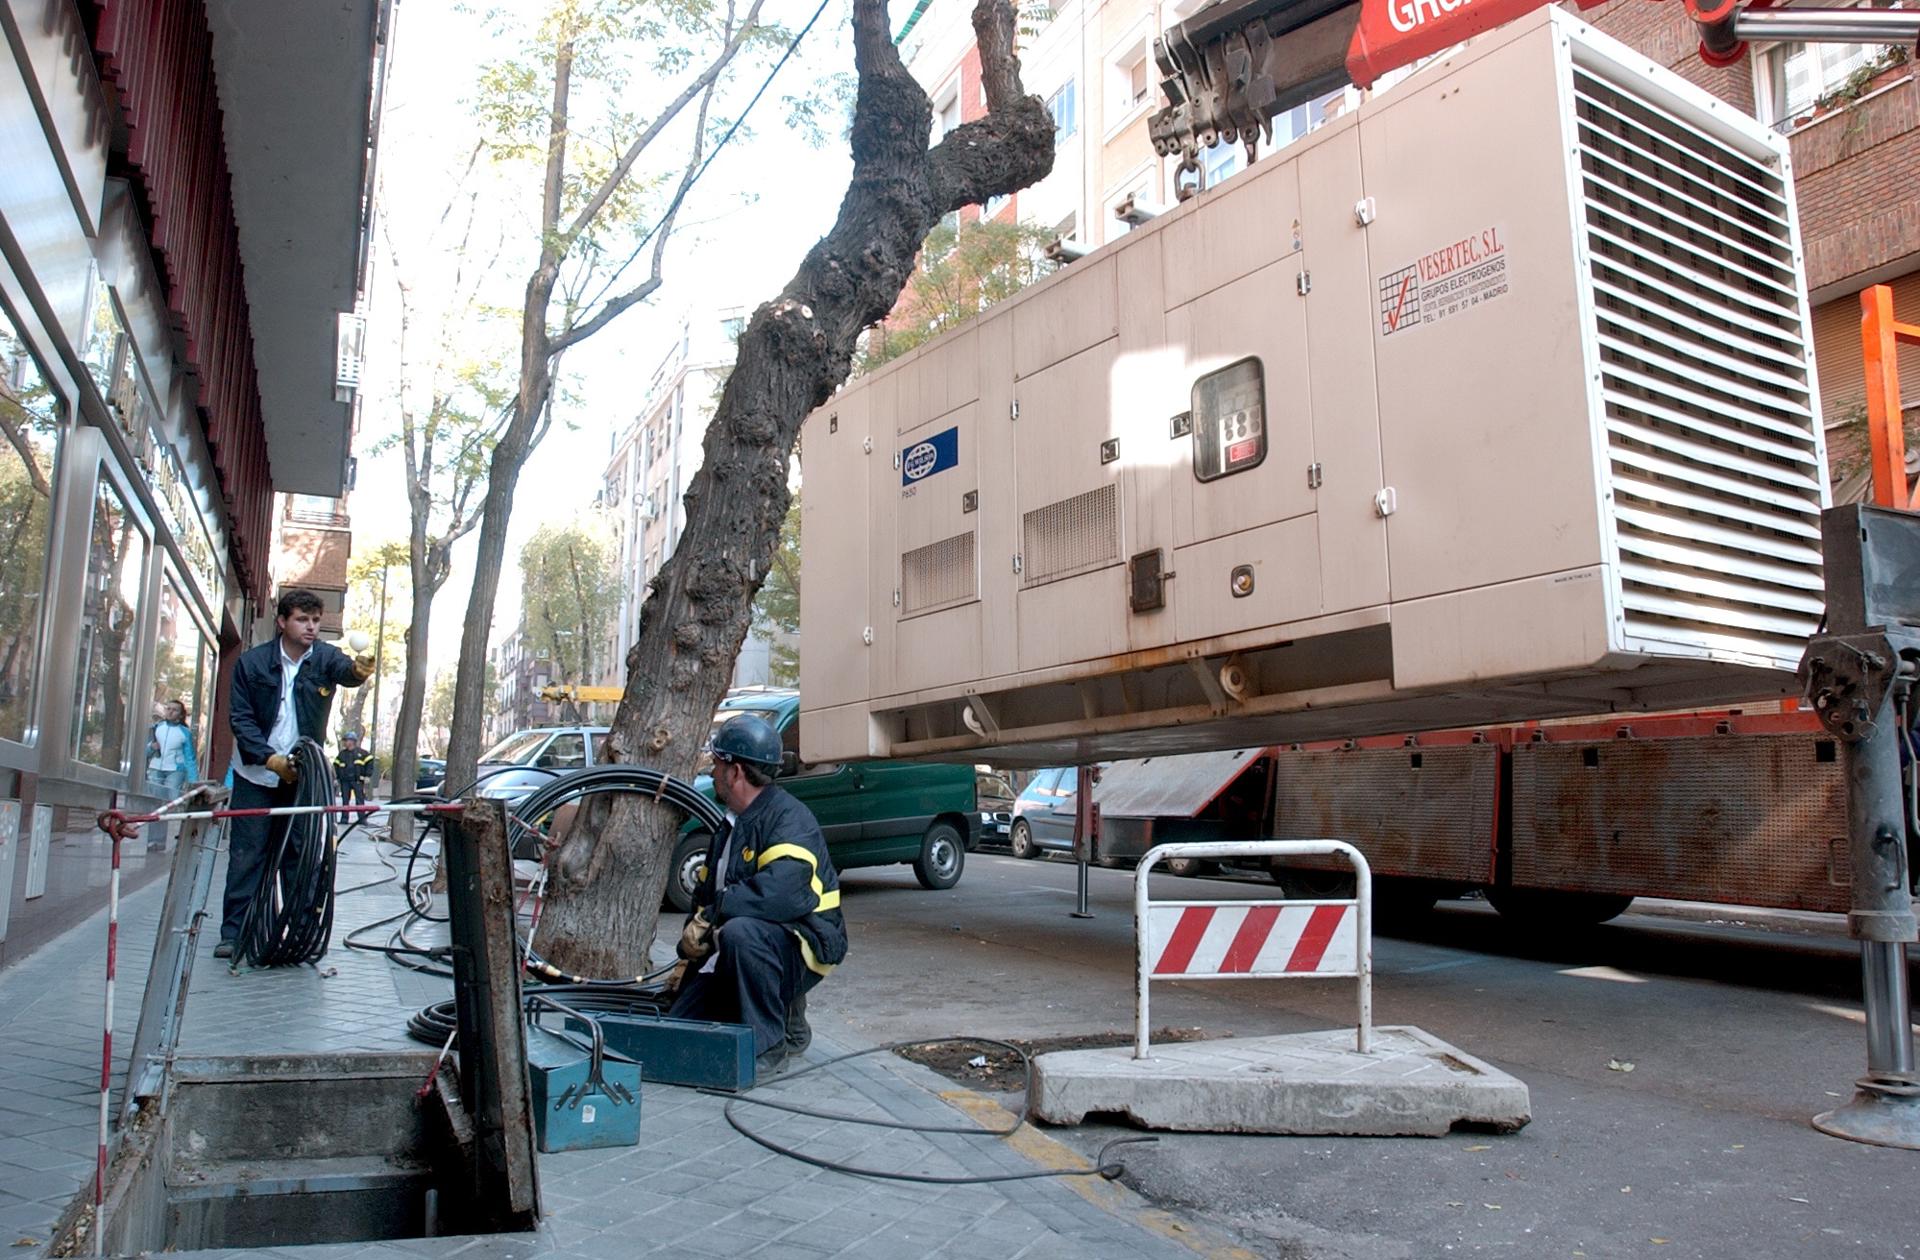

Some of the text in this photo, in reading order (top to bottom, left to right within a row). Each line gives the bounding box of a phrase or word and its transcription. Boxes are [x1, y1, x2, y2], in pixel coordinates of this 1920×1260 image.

[1482, 227, 1504, 257] S.L.
[1421, 282, 1449, 301] GRUPOS
[1450, 260, 1506, 290] ELECTROGENOS
[1483, 284, 1508, 300] MADRID
